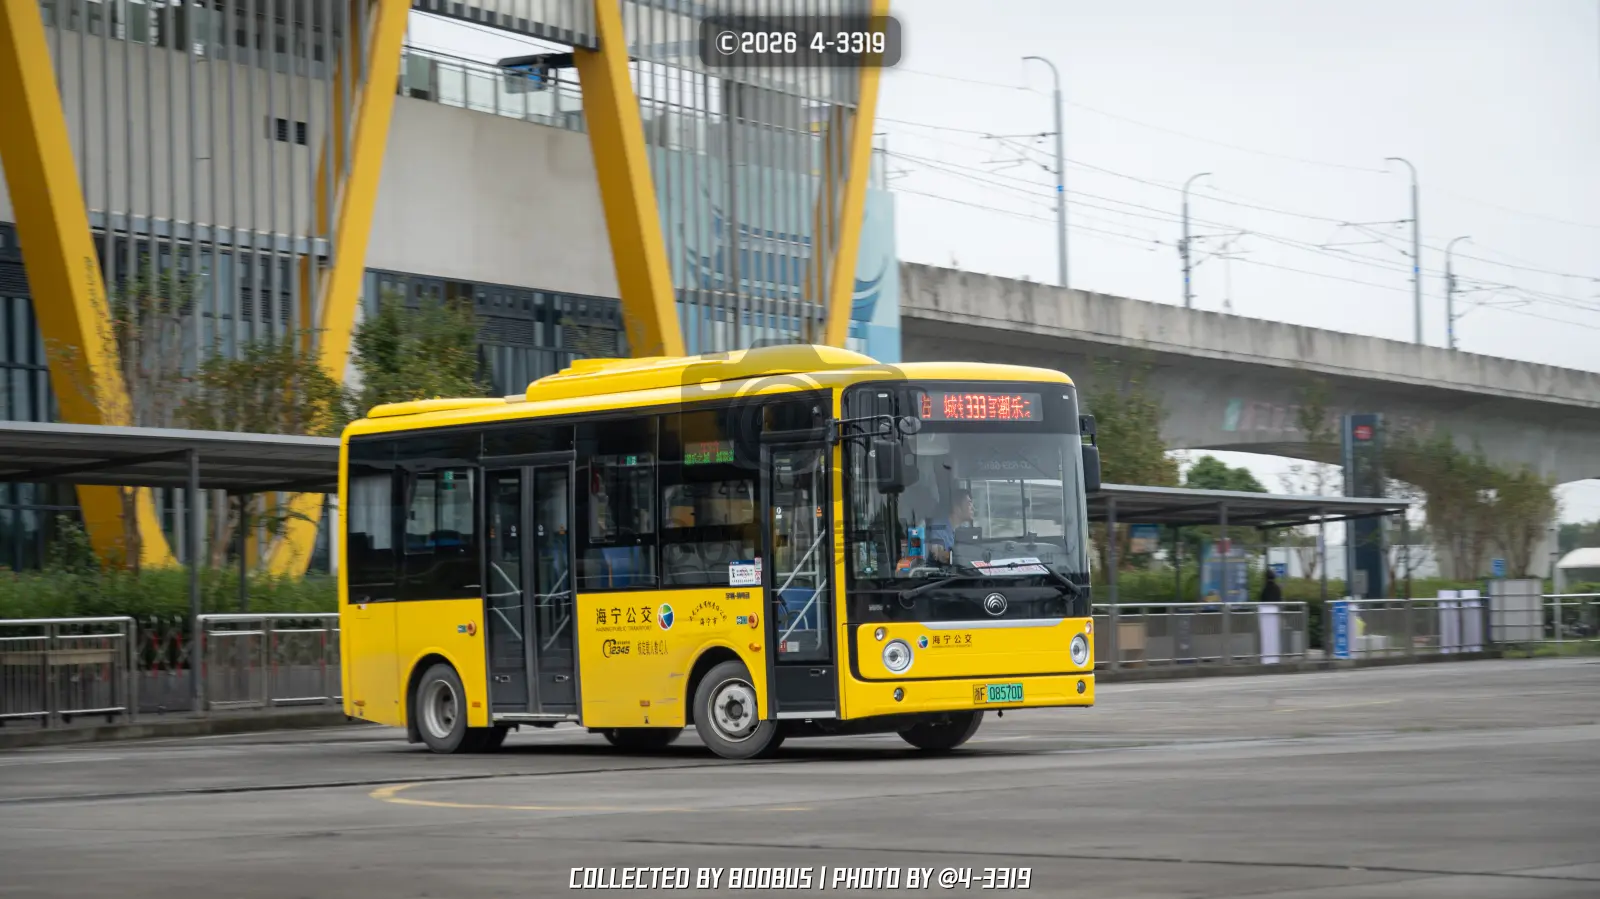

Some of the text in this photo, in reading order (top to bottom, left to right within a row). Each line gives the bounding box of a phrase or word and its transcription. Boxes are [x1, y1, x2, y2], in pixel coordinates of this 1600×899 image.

[596, 606, 652, 625] 海宁公交
[932, 634, 972, 645] 海宁公交
